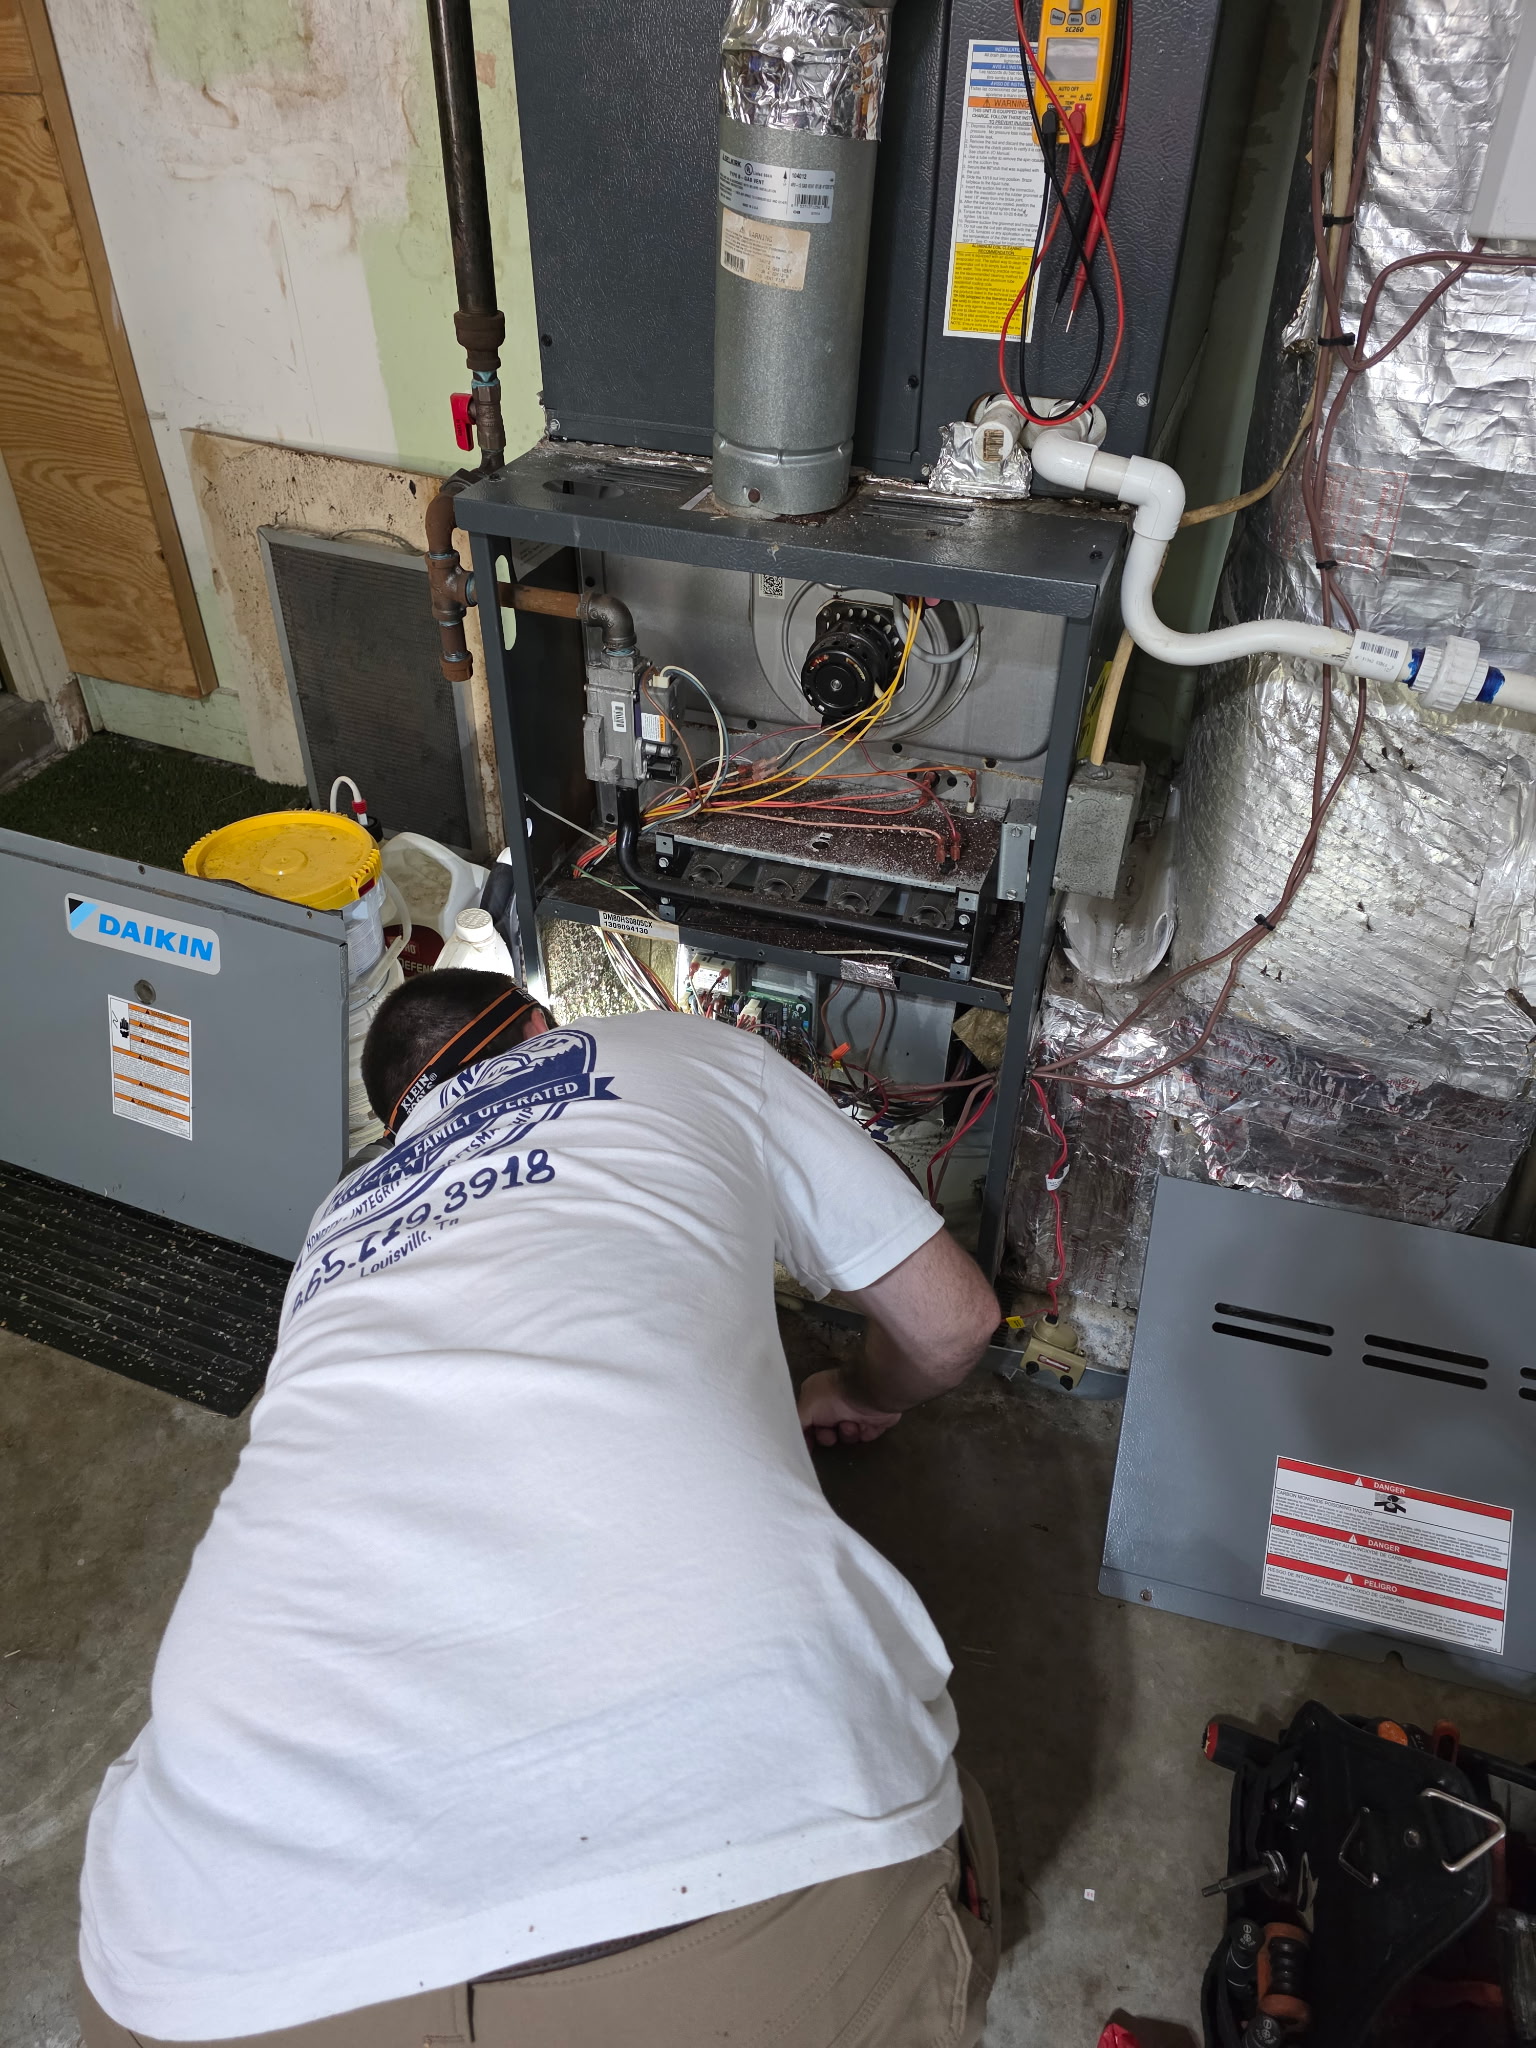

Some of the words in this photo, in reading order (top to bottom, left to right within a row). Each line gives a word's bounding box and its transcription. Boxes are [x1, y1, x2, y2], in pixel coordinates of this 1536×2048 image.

[994, 100, 1029, 108] WARNING
[722, 153, 742, 168] SELKIRK
[604, 921, 648, 934] 1309094130
[98, 914, 213, 961] DAIKIN
[414, 1113, 472, 1158] FAMILY
[477, 1082, 579, 1118] OPERATED
[360, 1230, 432, 1278] Louisville,
[1373, 1482, 1406, 1495] DANGER
[1276, 1490, 1296, 1499] CARBON
[1353, 1507, 1373, 1516] HAZARD
[1368, 1539, 1400, 1553] DANGER
[1389, 1554, 1412, 1564] CARBONE
[1267, 1567, 1285, 1576] RIESGO
[1331, 1581, 1343, 1589] POR
[1379, 1592, 1404, 1604] CARBONO
[1364, 1579, 1398, 1593] PELIGRO
